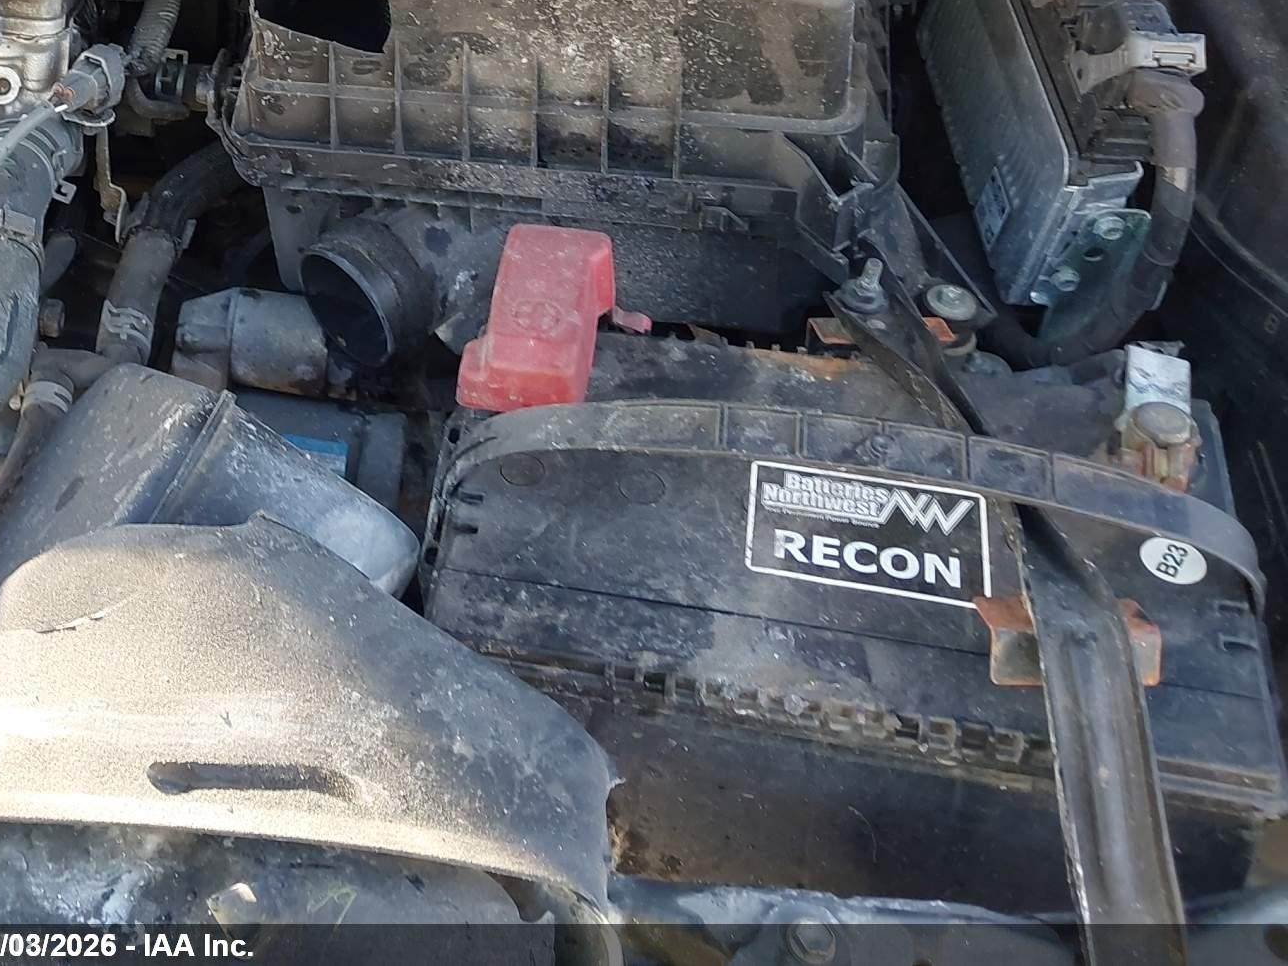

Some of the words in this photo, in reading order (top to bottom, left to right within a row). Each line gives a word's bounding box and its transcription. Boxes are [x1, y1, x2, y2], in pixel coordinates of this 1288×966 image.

[761, 482, 881, 517] Northwest
[784, 471, 890, 504] Batteries
[774, 528, 961, 588] RECON
[1155, 544, 1188, 578] B23
